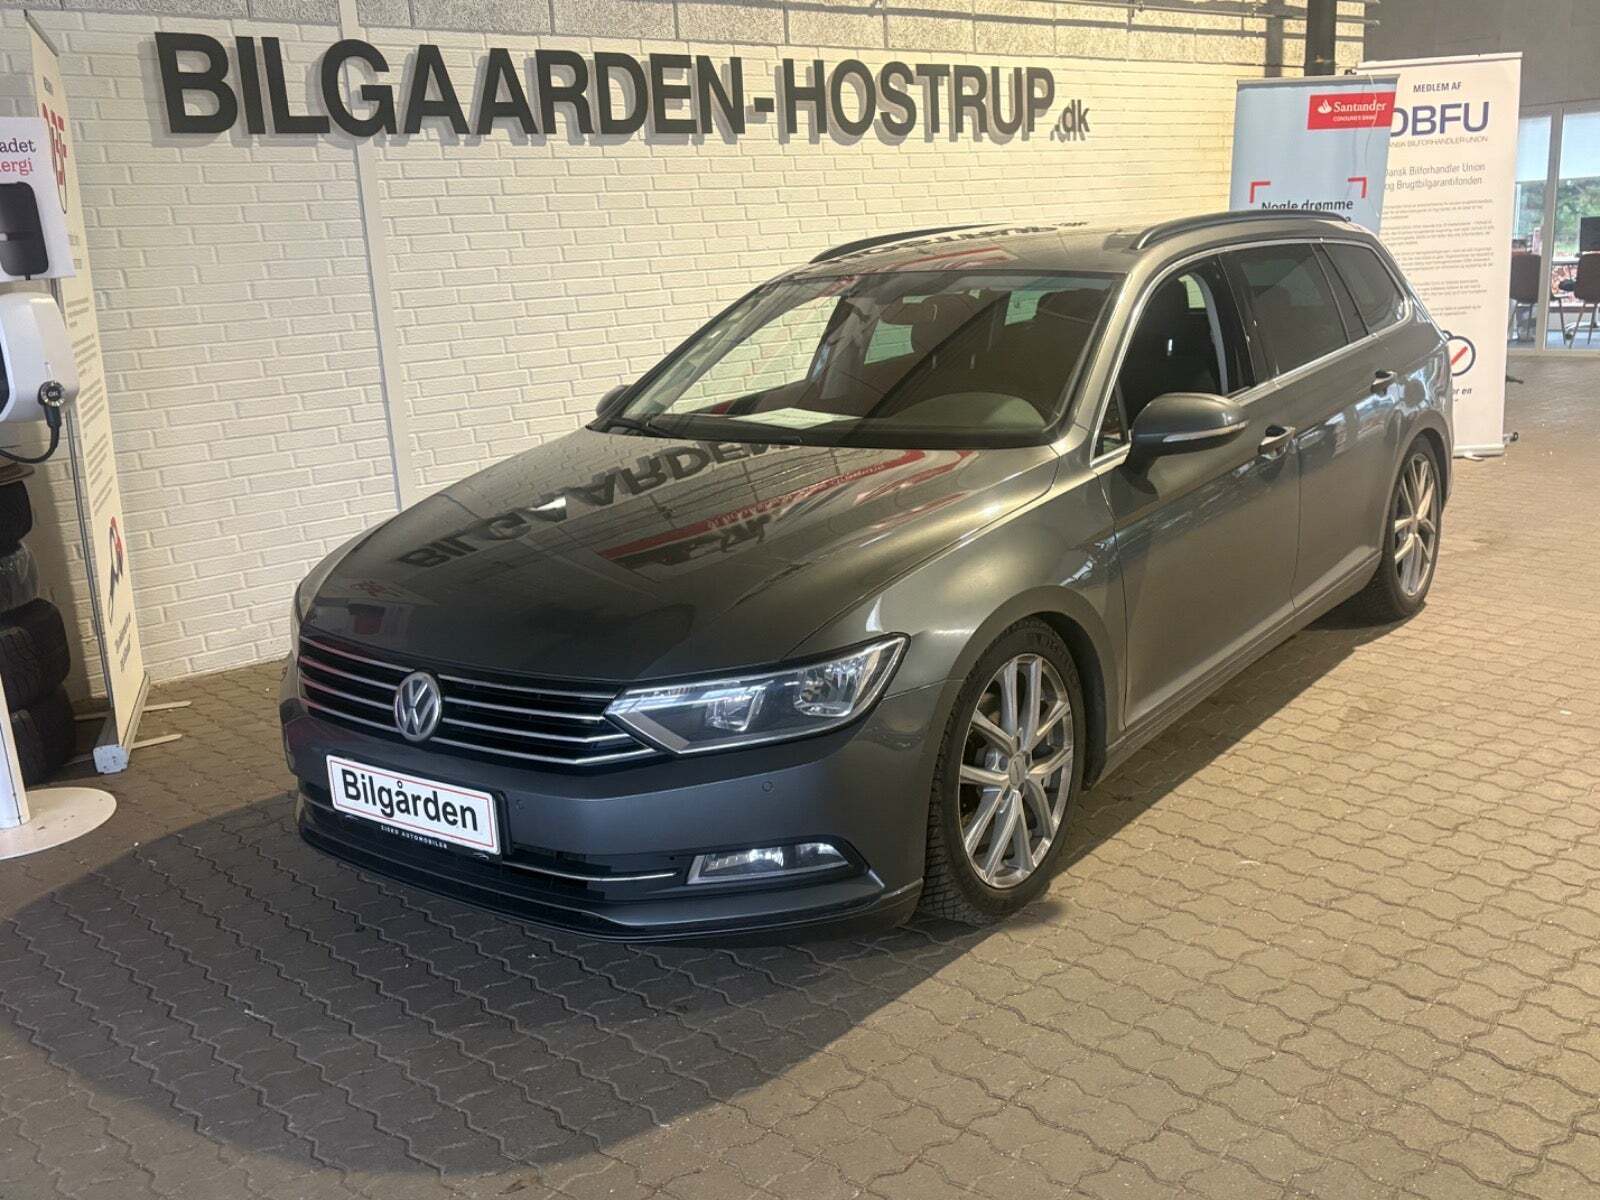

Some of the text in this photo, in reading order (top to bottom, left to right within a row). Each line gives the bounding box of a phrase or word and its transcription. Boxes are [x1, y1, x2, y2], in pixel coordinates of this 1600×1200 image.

[1413, 82, 1462, 93] MEDLEM AF
[1333, 99, 1387, 112] Santander
[1391, 102, 1489, 137] DBFU
[0, 158, 33, 176] ergi
[1409, 163, 1460, 176] Bilforhandler
[1462, 162, 1486, 172] Union
[1301, 199, 1354, 211] drømme
[341, 768, 479, 831] Bilgården
